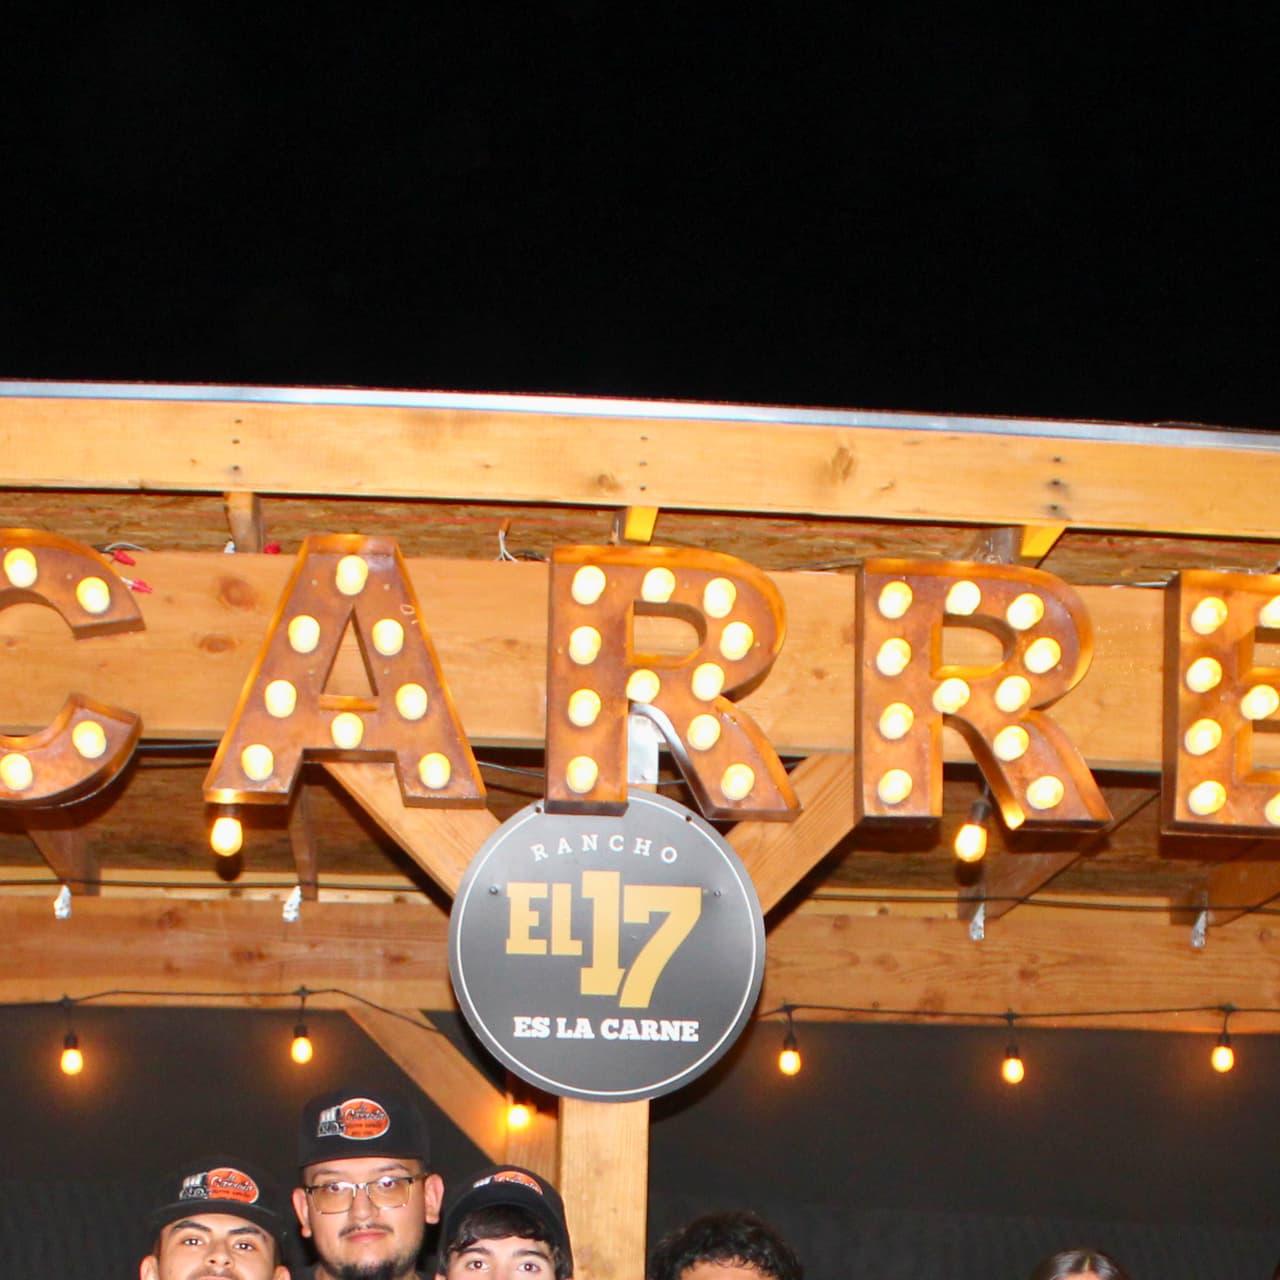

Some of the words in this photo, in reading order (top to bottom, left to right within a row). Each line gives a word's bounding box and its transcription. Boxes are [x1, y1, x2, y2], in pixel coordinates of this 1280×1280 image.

[530, 834, 678, 864] RANCHO
[580, 869, 702, 1009] 17
[513, 1016, 551, 1038] ES
[556, 1018, 595, 1040] LA
[600, 1019, 700, 1043] CARNE
